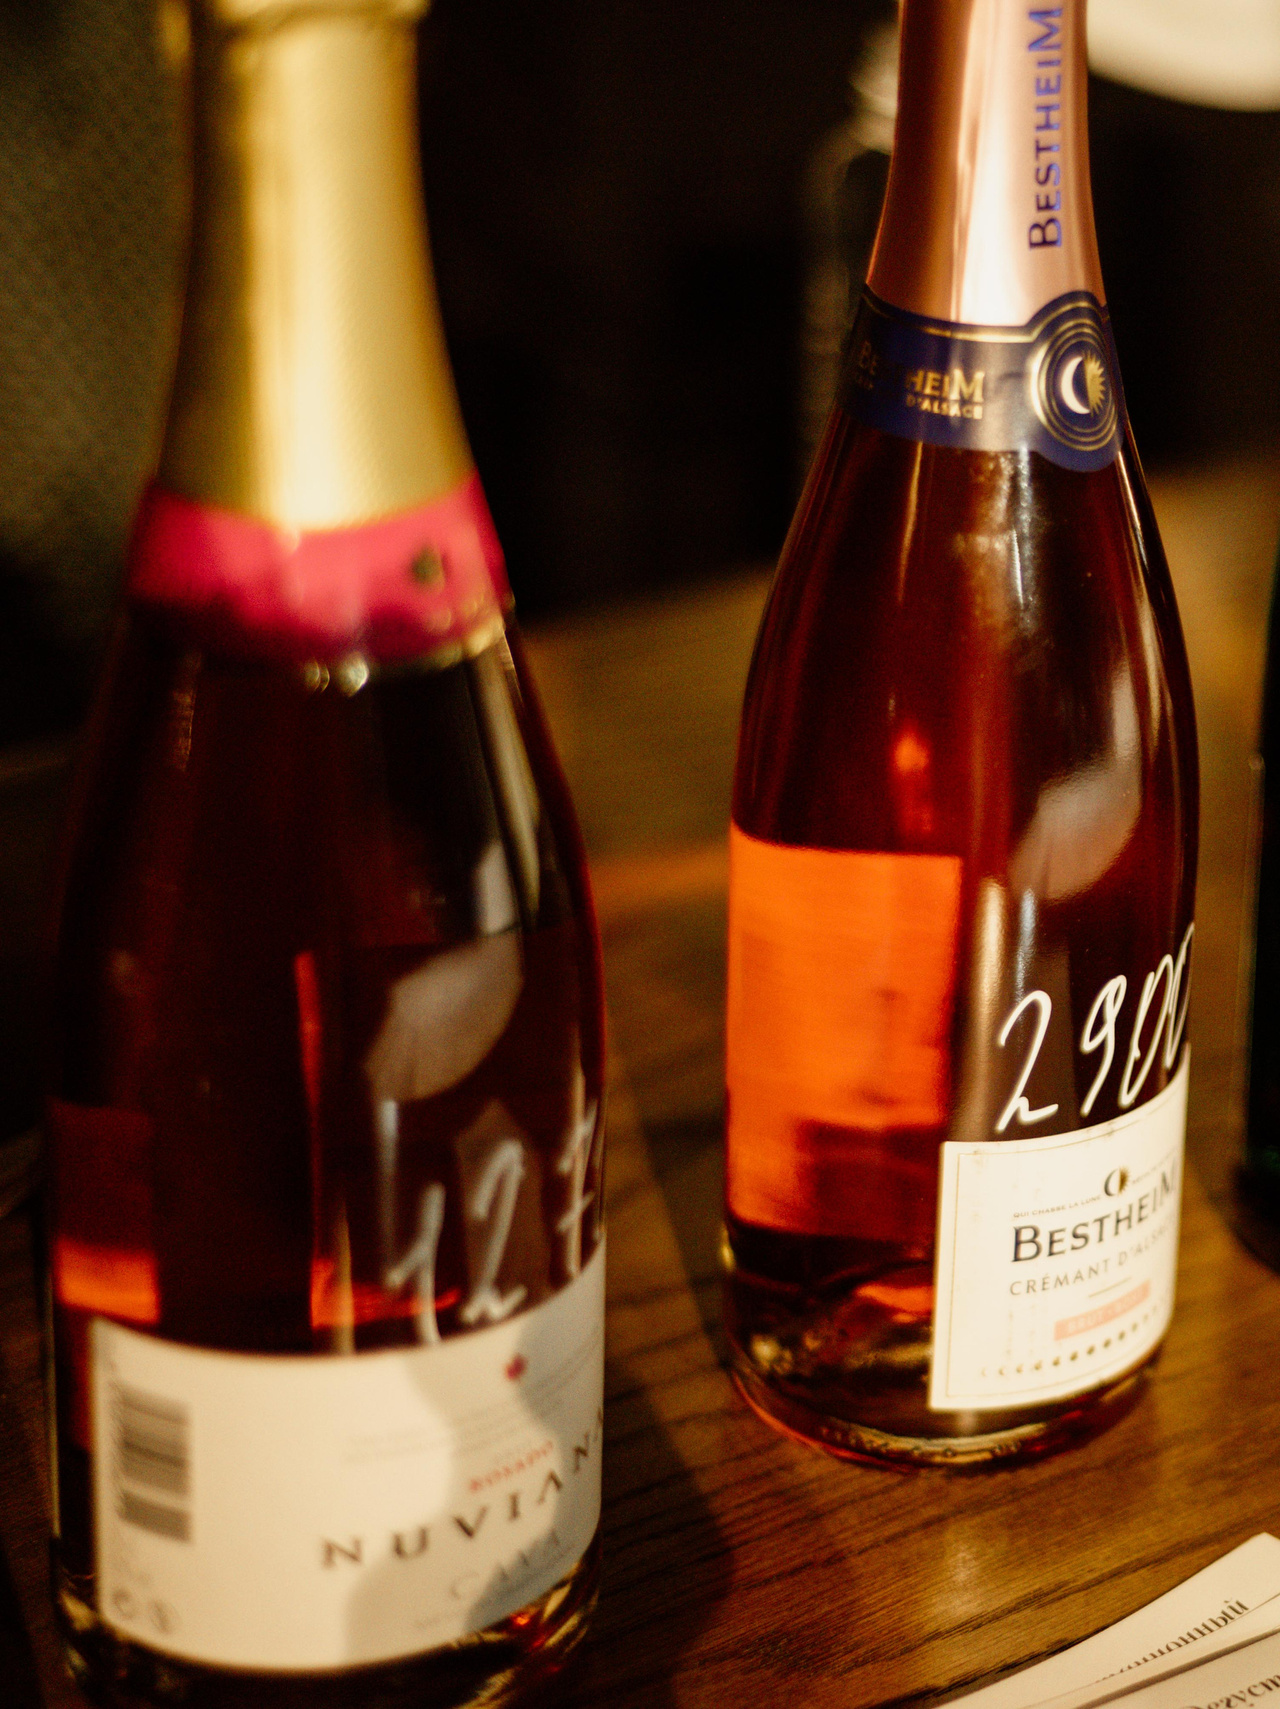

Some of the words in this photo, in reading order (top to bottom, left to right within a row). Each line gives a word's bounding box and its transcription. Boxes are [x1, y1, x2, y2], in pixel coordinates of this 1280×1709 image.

[1028, 7, 1063, 250] BESTHEIM
[996, 922, 1195, 1132] 2900
[1009, 1257, 1112, 1297] CRÉMANT
